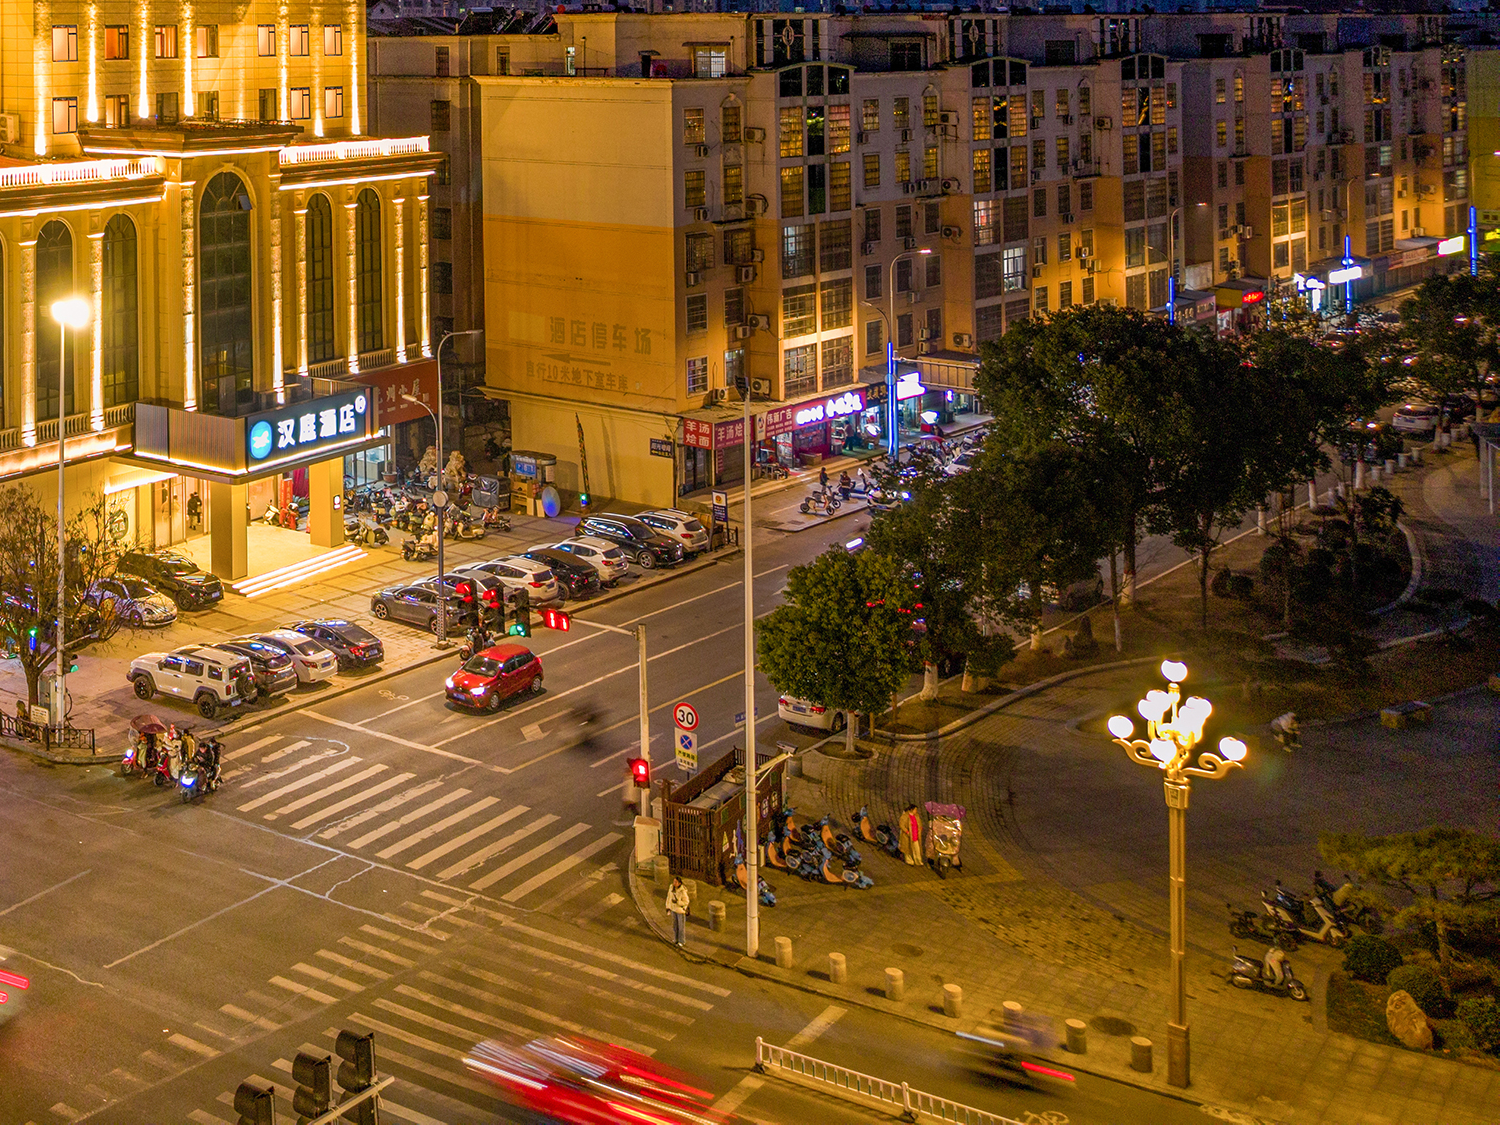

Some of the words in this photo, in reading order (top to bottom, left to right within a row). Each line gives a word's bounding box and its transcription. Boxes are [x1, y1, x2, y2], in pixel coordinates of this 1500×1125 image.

[549, 316, 652, 356] 酒店停车场
[766, 408, 792, 425] 伟新广告
[276, 403, 356, 449] 汉庭酒店
[685, 420, 710, 434] 羊汤
[716, 424, 744, 441] 羊汤烩
[685, 433, 710, 447] 烩面
[678, 709, 695, 726] 30
